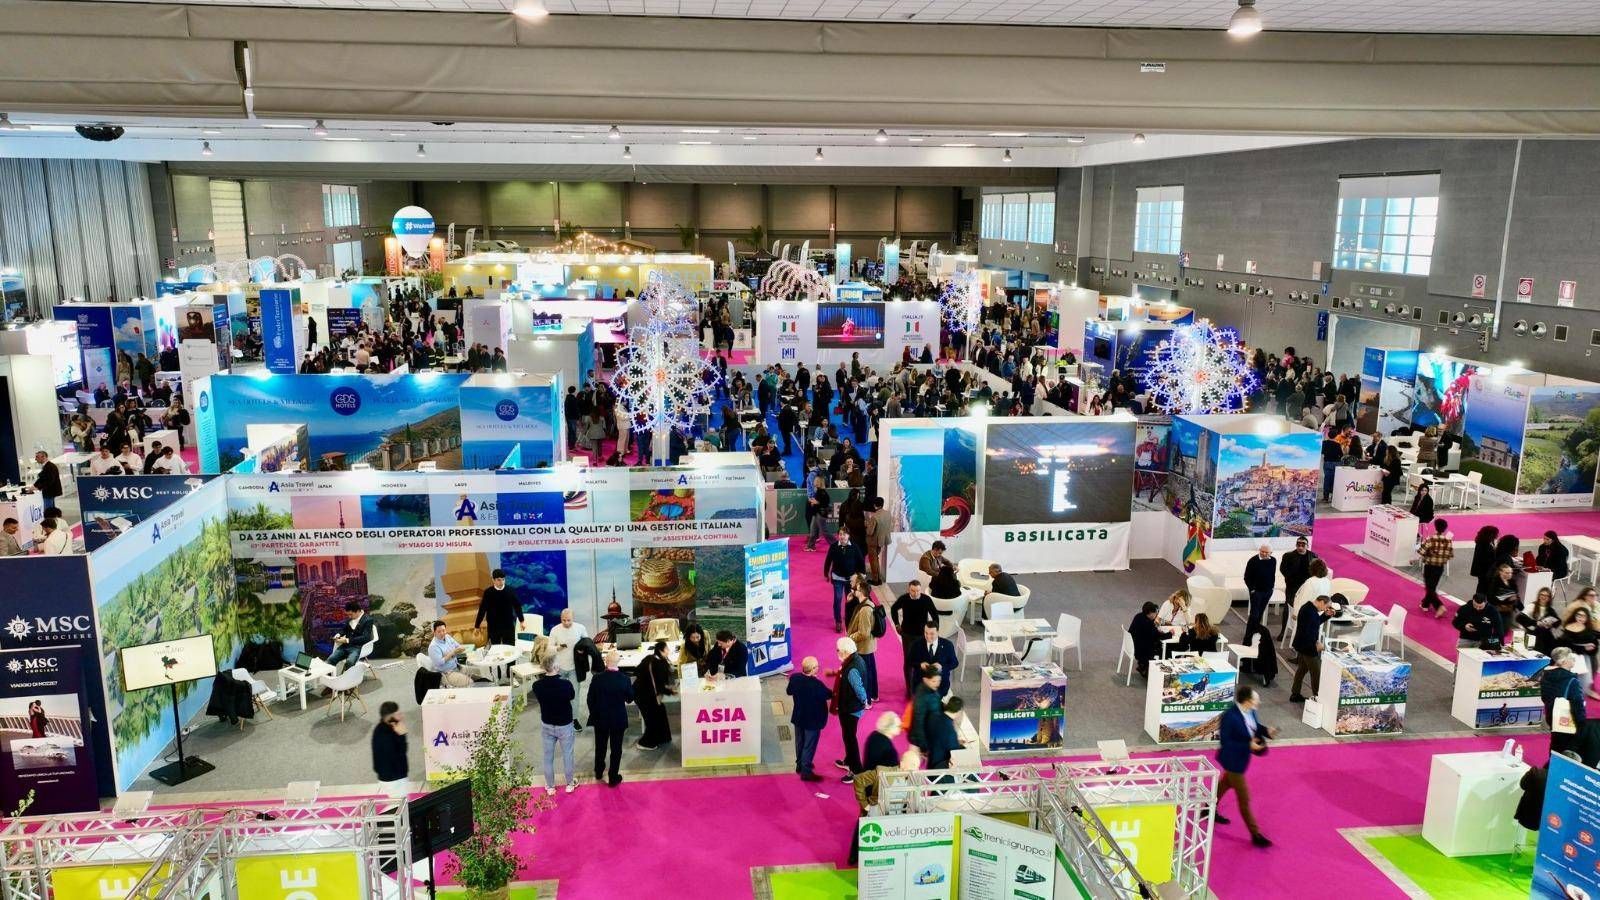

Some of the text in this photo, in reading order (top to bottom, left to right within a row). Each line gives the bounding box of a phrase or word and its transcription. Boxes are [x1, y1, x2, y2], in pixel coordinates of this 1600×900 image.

[335, 394, 356, 403] GDS
[112, 486, 152, 500] MSC
[161, 518, 170, 529] Asia
[171, 508, 184, 522] Travel
[388, 529, 445, 538] OPERATORI
[449, 527, 525, 536] PROFESSIONALI
[529, 526, 551, 535] CON
[650, 522, 697, 531] GESTIONE
[35, 615, 91, 633] MSC
[24, 658, 58, 669] MSC
[696, 708, 746, 723] ASIA
[702, 728, 741, 744] LIFE
